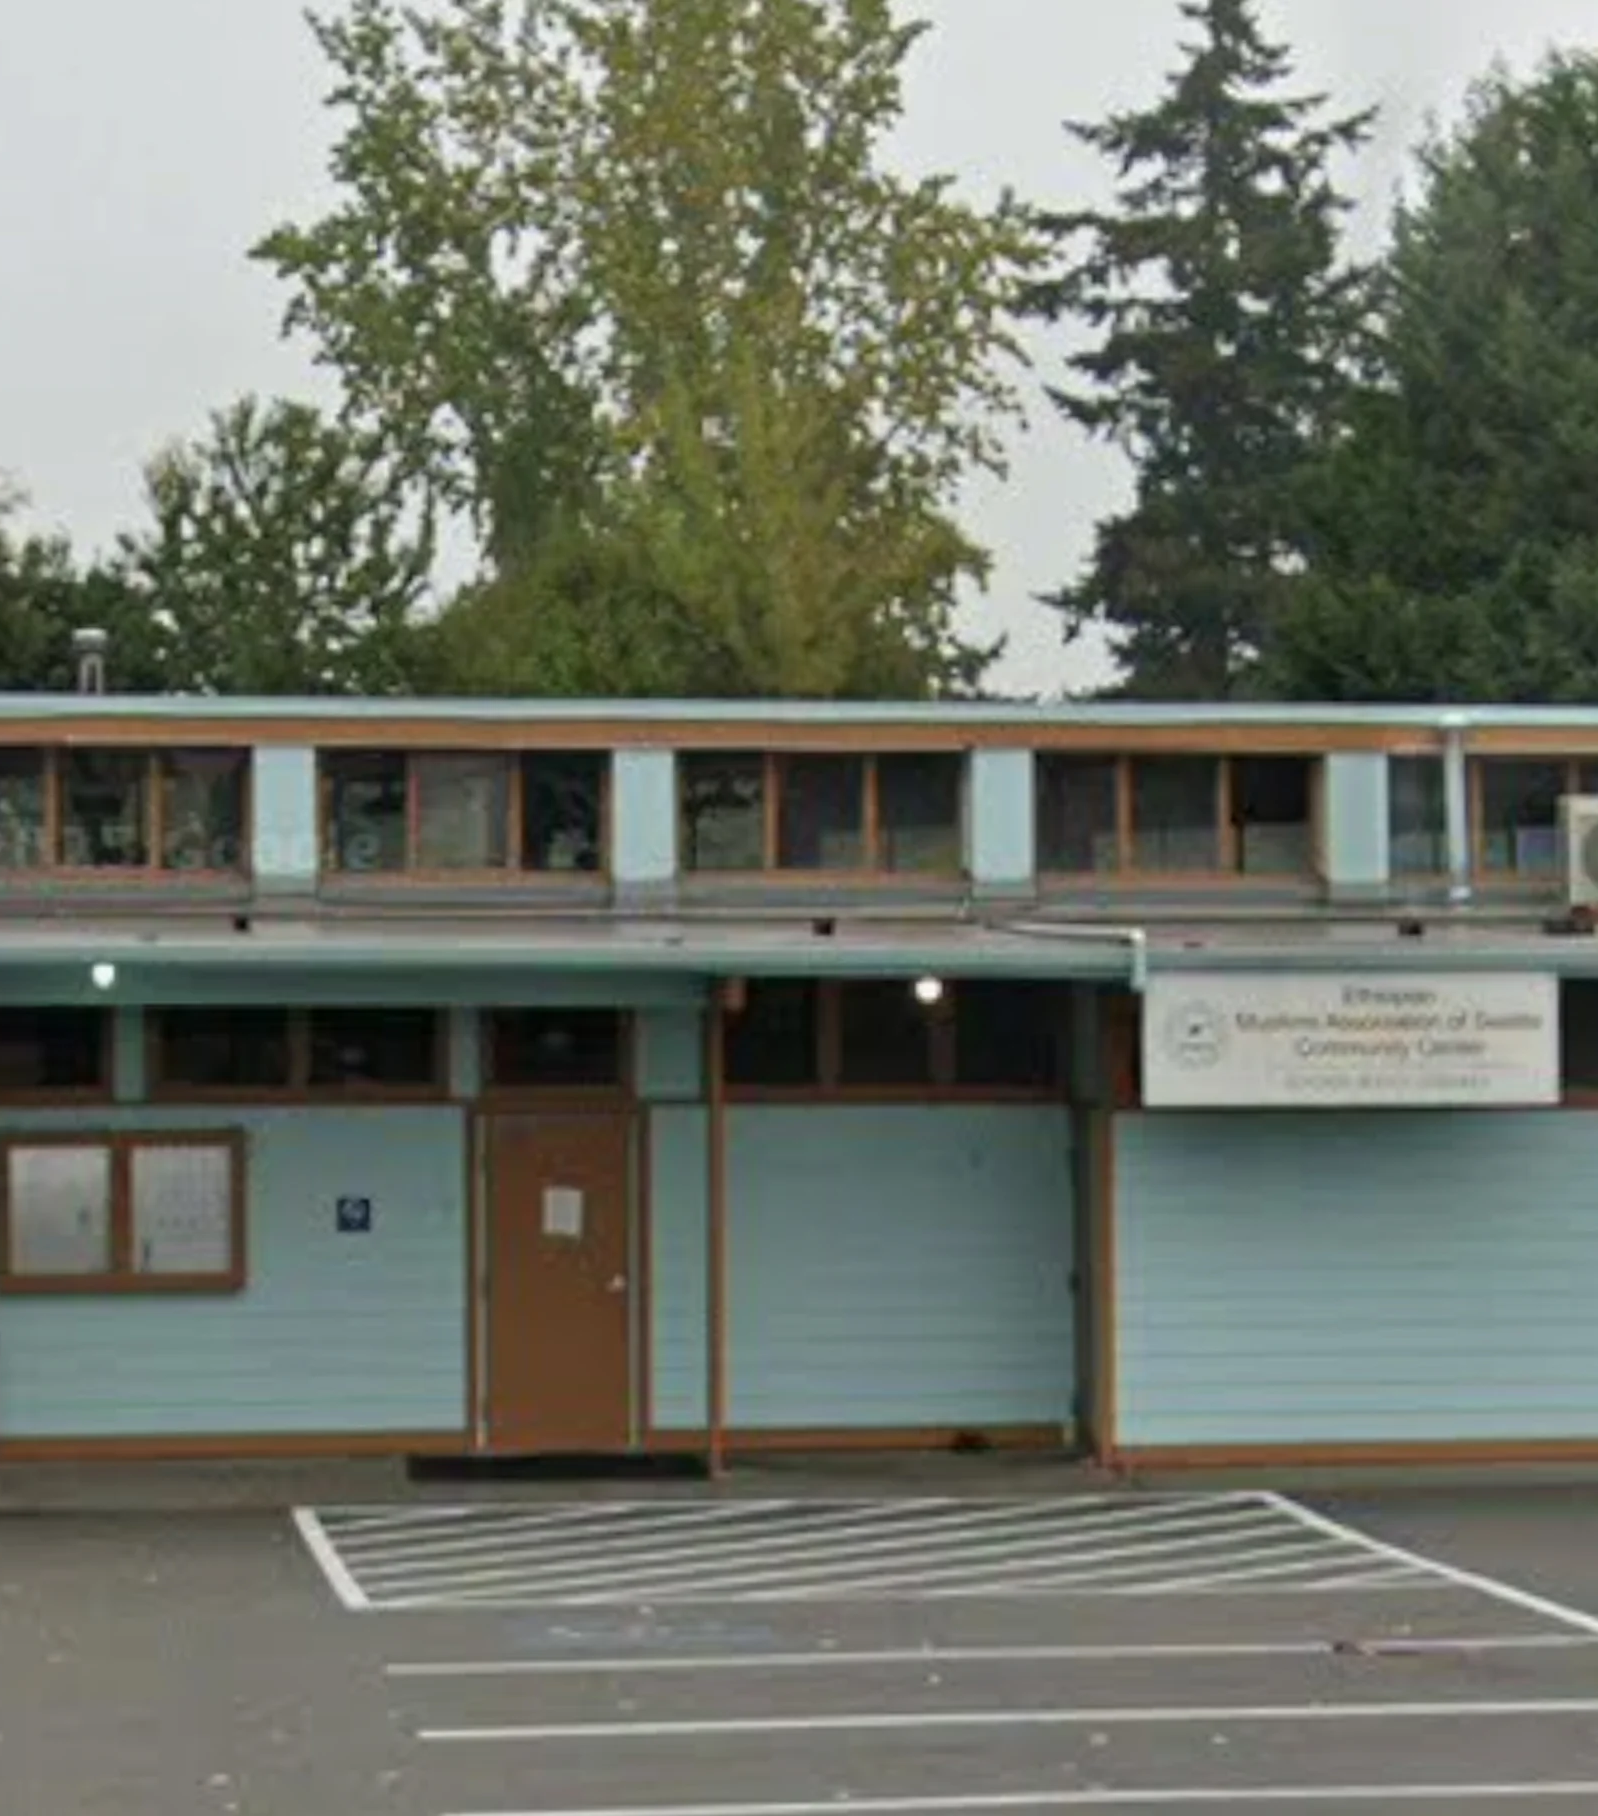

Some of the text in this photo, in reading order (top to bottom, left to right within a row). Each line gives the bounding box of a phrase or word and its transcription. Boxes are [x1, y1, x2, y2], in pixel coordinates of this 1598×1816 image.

[1327, 1012, 1440, 1031] Association
[1447, 1011, 1466, 1031] of
[1294, 1037, 1487, 1062] Community Center
